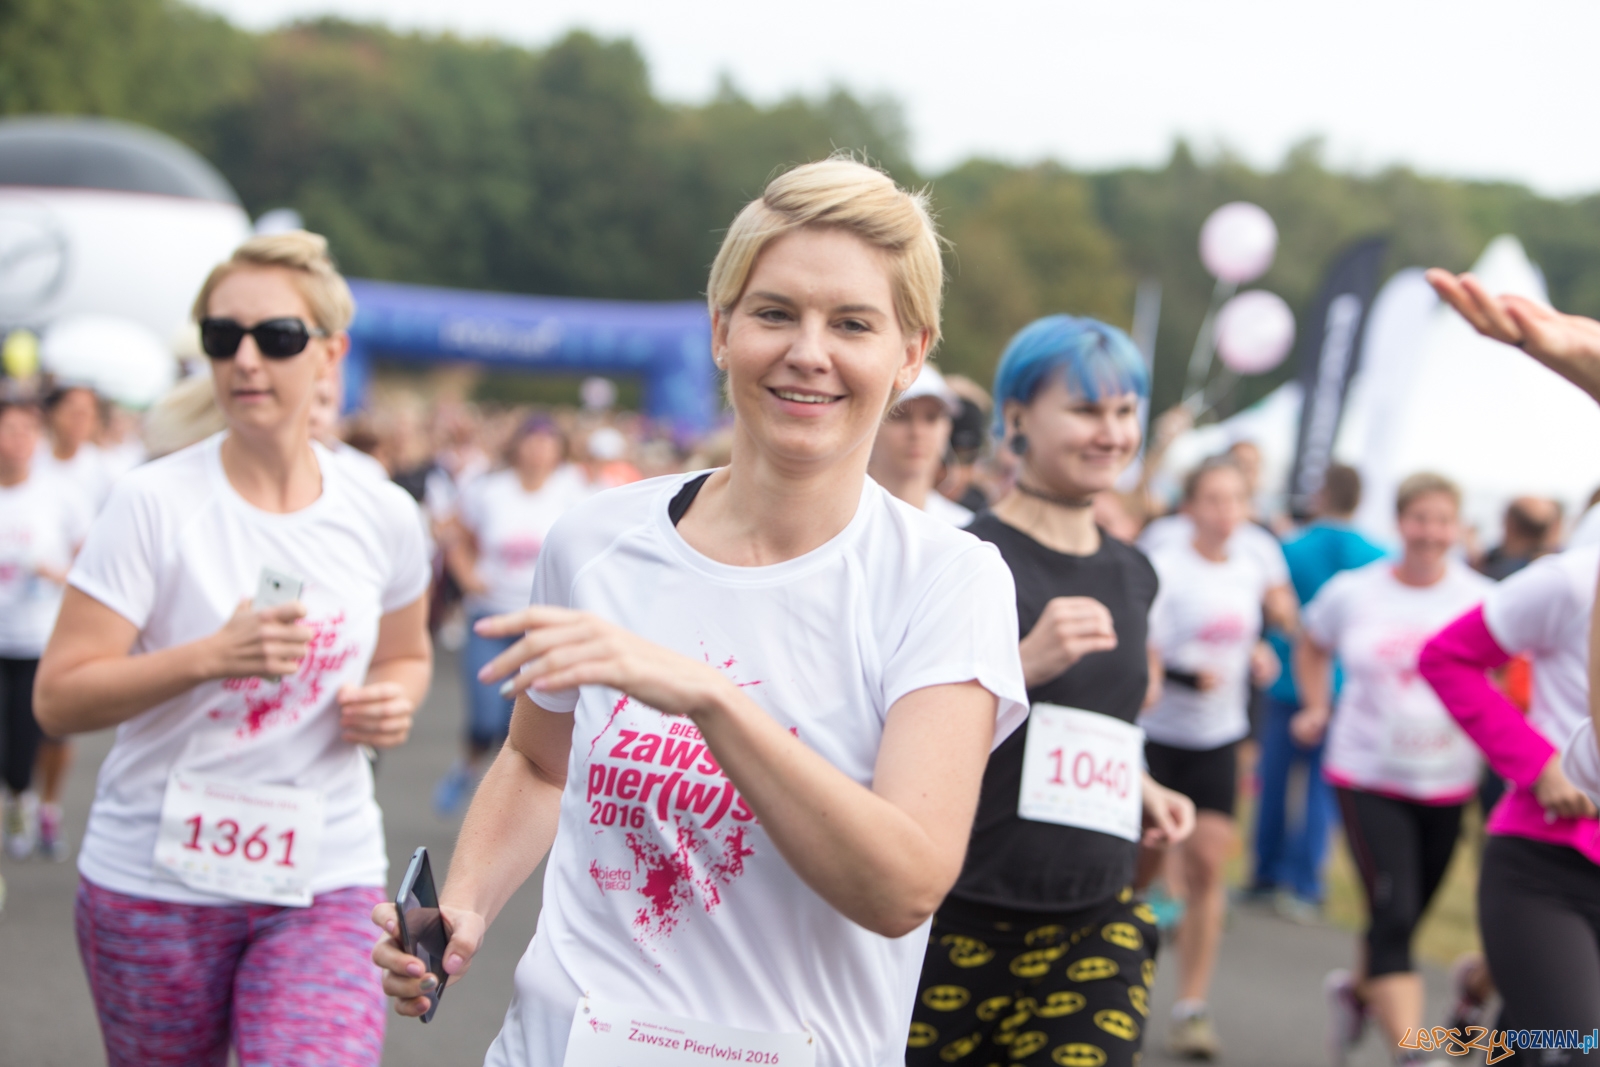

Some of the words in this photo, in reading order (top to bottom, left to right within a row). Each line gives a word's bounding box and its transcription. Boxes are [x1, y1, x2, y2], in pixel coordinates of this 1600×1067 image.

[587, 763, 761, 830] pier(w)s
[1047, 746, 1132, 800] 1040
[181, 813, 296, 869] 1361
[589, 800, 646, 829] 2016
[628, 1027, 680, 1050] Zawsze
[683, 1038, 742, 1062] Pier(w)si
[745, 1050, 780, 1065] 2016
